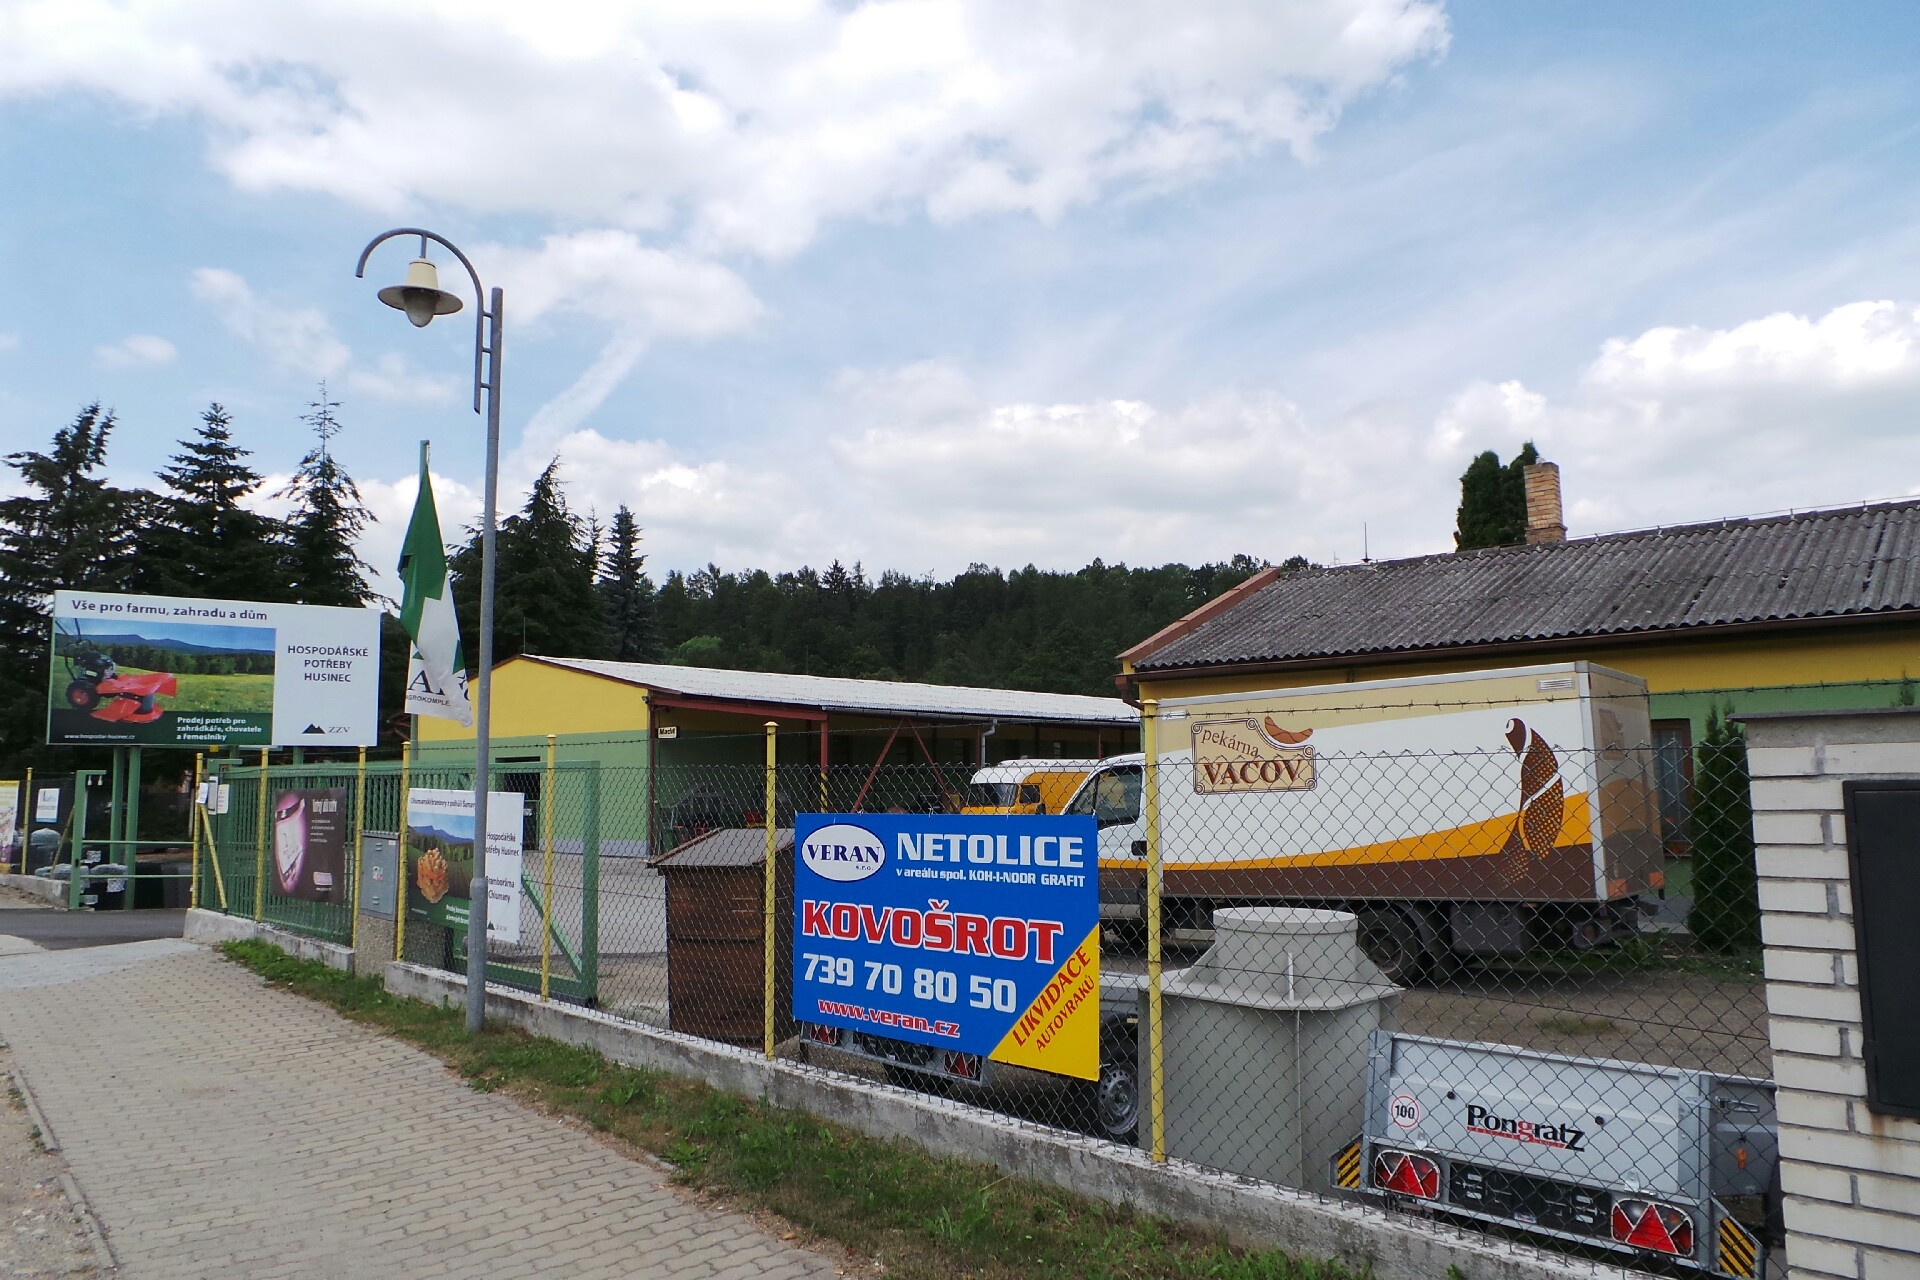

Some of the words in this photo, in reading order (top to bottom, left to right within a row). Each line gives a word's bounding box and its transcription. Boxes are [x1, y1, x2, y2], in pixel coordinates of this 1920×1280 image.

[71, 599, 96, 611] Vše
[99, 602, 123, 613] pro
[126, 602, 170, 616] farmu,
[173, 606, 226, 618] zahradu
[229, 611, 236, 619] a
[239, 609, 268, 621] dům
[287, 645, 369, 657] HOSPODÁŘSKÉ
[303, 658, 353, 669] POTŘEBY
[303, 672, 352, 682] HUSINEC
[406, 694, 452, 707] GROKOMPLE
[176, 725, 224, 733] zahrádkáře,
[225, 725, 262, 733] chovatele
[177, 716, 204, 725] Prodej
[205, 717, 232, 725] potřeb
[233, 718, 247, 726] pro
[183, 733, 227, 741] řemeslníky
[1201, 729, 1259, 758] pekárna
[1203, 759, 1302, 785] VACOV
[486, 845, 500, 856] otřeby
[805, 844, 881, 864] VERAN
[897, 832, 1084, 868] NETOLICE
[896, 868, 902, 876] v
[904, 867, 938, 878] areálu
[940, 870, 967, 882] spol.
[969, 870, 1036, 885] KOH-I-NOOR
[1041, 873, 1086, 888] GRAFIT
[802, 898, 1064, 965] KOVOŠROT
[802, 952, 854, 987] 739
[864, 961, 902, 995] 70
[913, 968, 957, 1004] 80
[969, 975, 1017, 1013] 50
[1011, 945, 1091, 1048] LIKVIDACE
[817, 998, 960, 1038] www.veran.cz
[1035, 974, 1096, 1053] AUTOVRAKŮ
[1395, 1104, 1416, 1120] 100
[1466, 1104, 1586, 1152] Pongratz
